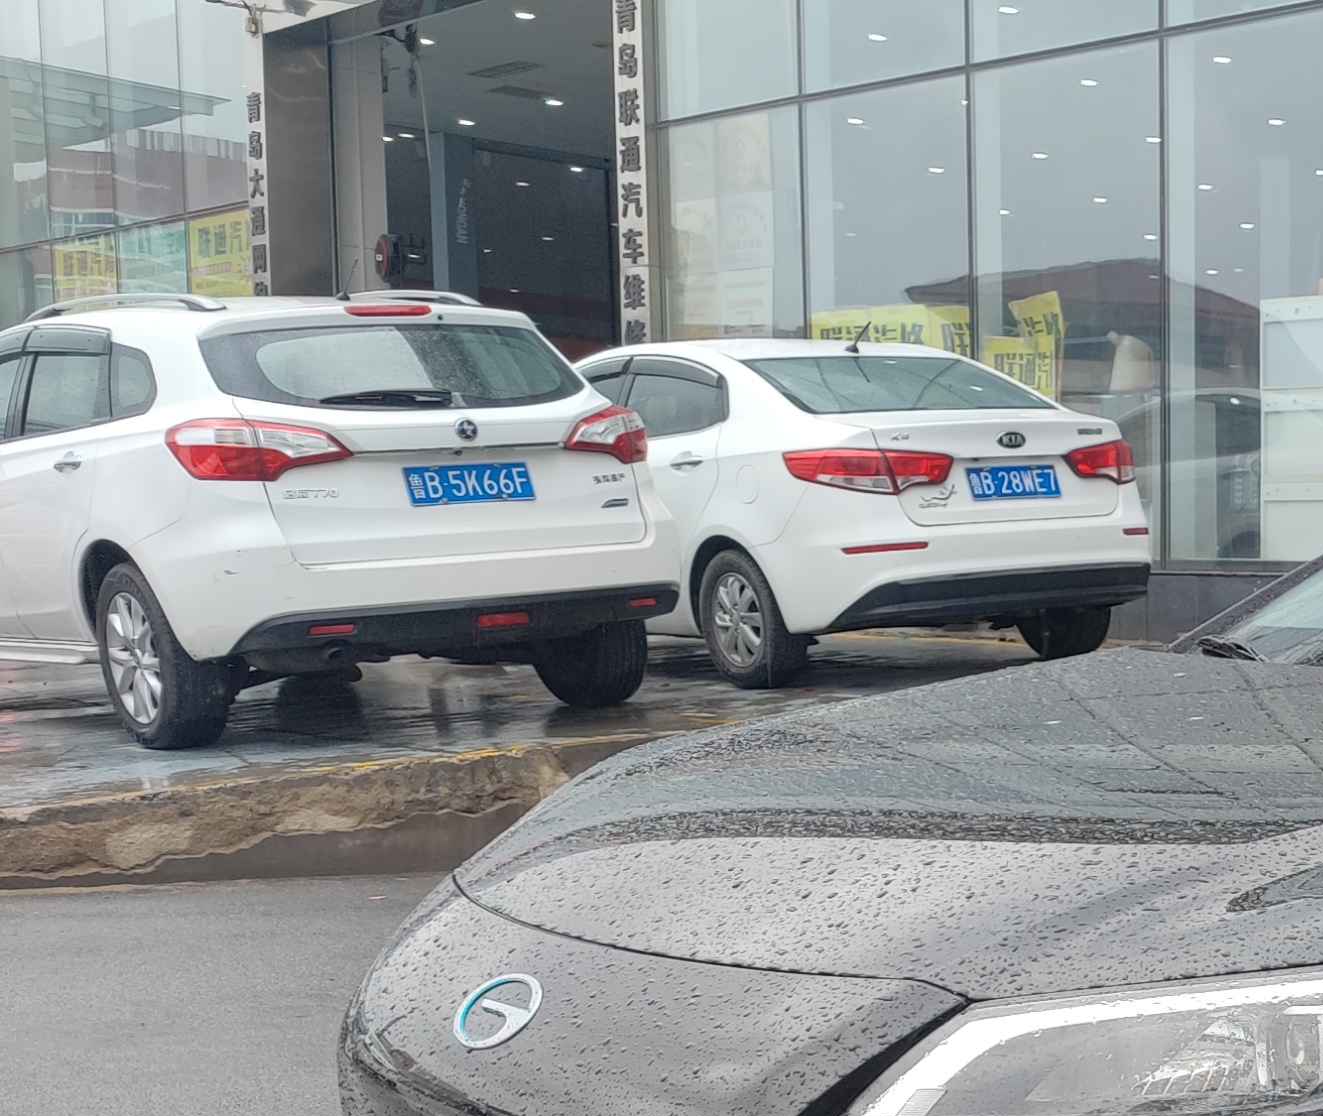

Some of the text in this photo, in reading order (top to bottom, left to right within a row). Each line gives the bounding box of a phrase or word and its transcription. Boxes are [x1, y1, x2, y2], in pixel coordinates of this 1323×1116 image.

[616, 0, 646, 345] 青岛联通汽车维修
[198, 219, 250, 259] 联通汽
[993, 351, 1054, 390] 联通汽
